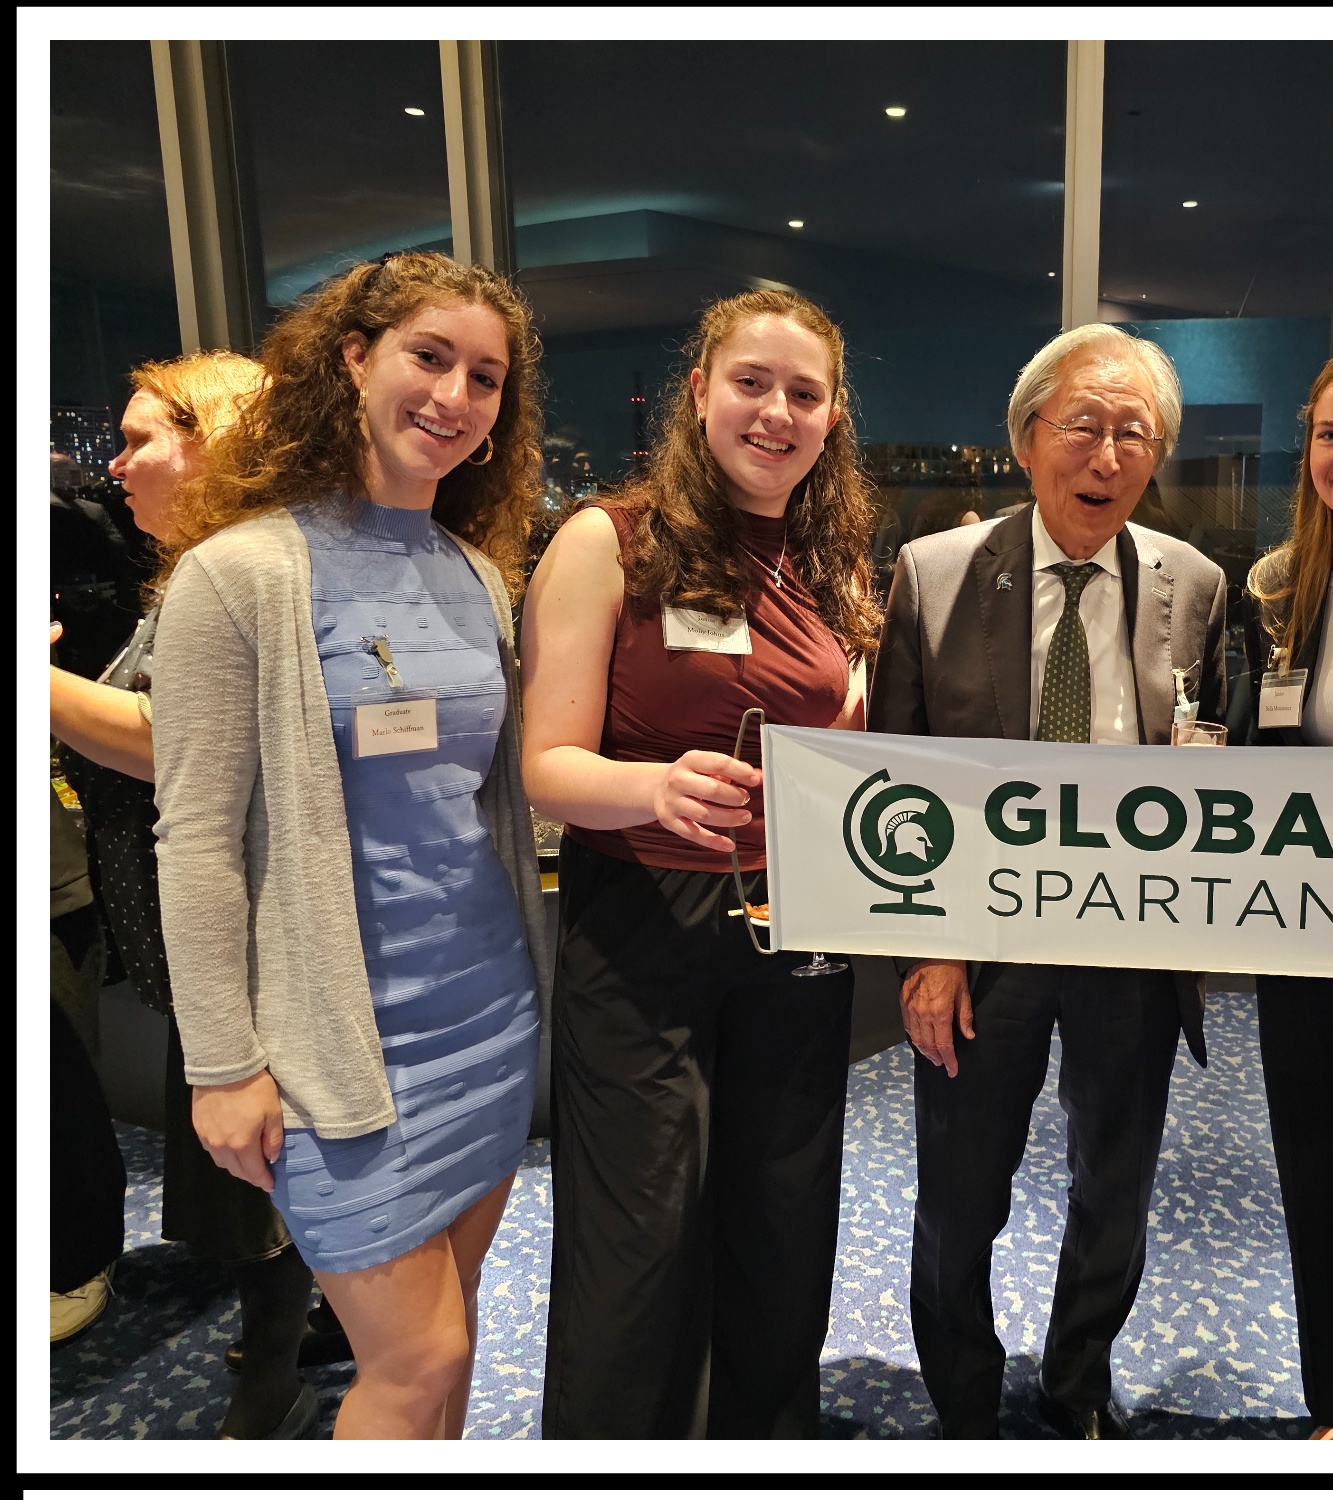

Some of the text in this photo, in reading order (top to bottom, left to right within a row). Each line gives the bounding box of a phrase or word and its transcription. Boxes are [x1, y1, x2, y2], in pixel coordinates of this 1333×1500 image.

[384, 708, 412, 717] Graduate
[371, 723, 425, 737] Marlo Schiffman
